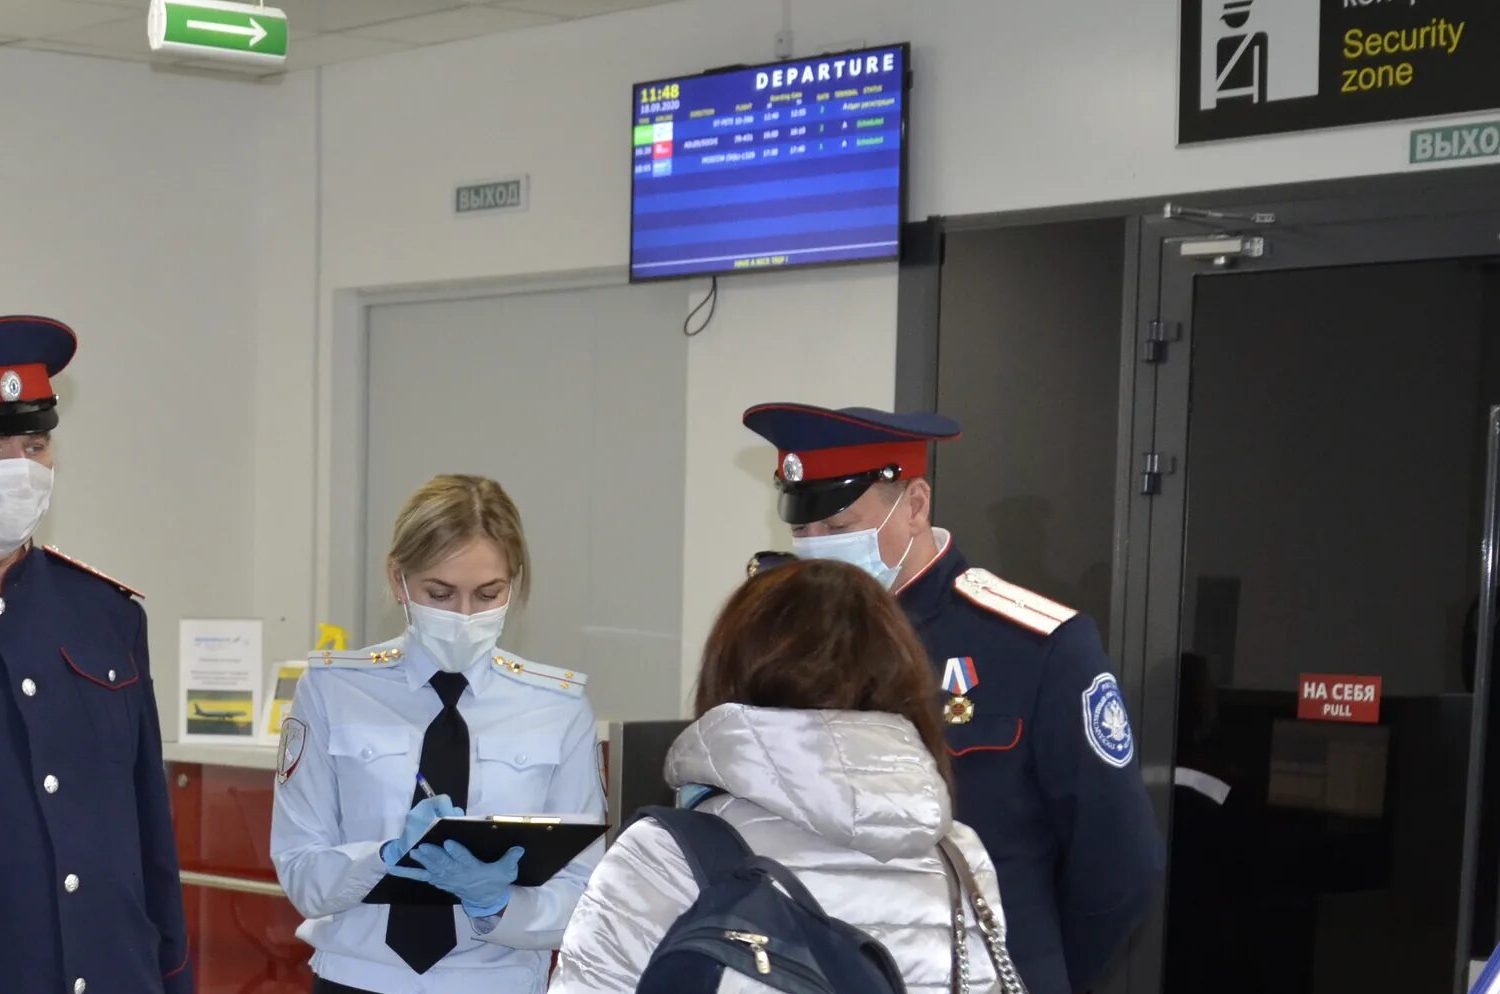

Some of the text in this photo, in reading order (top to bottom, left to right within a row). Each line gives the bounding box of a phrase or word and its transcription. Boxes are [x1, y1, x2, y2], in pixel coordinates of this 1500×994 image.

[1343, 17, 1466, 59] Security
[755, 53, 895, 90] DEPARTURE
[1340, 62, 1414, 93] zone
[640, 84, 680, 103] 11:48
[1414, 125, 1500, 161] ВЫХО
[459, 182, 519, 210] ВЫХОД
[1303, 681, 1376, 702] НА СЕБЯ
[1323, 703, 1353, 717] PULL
